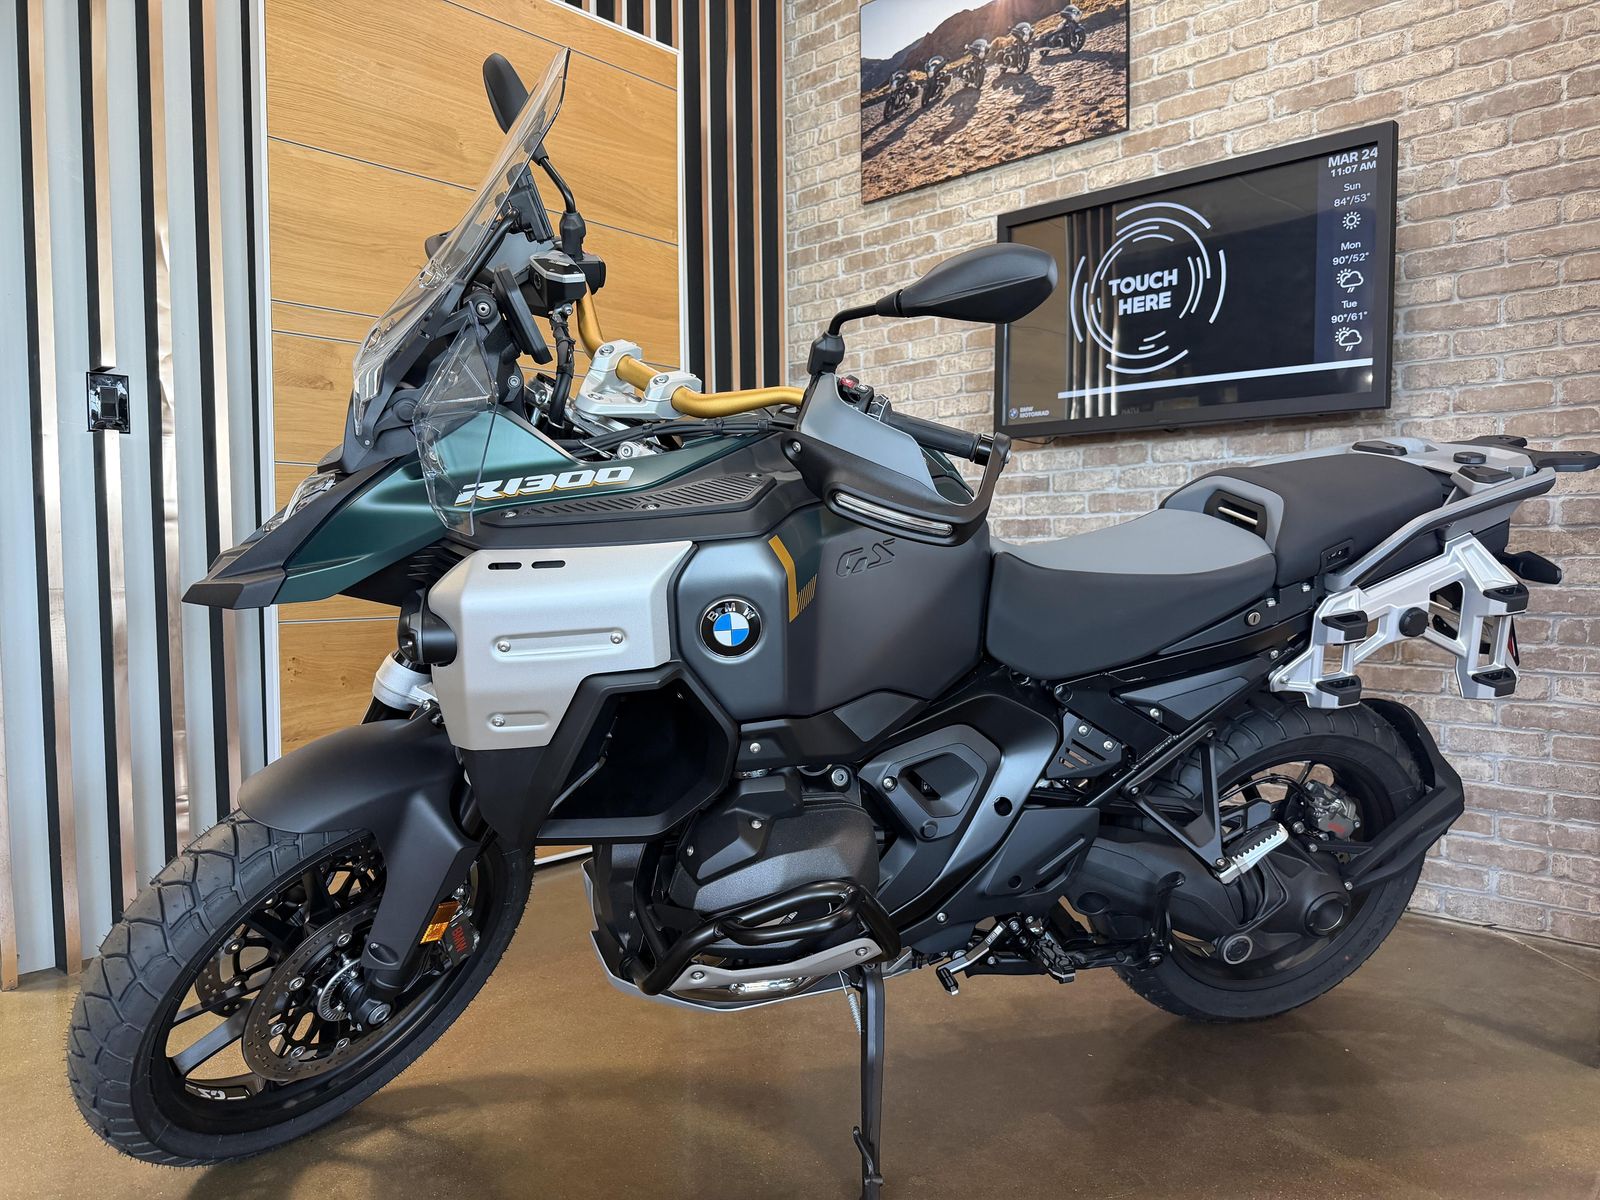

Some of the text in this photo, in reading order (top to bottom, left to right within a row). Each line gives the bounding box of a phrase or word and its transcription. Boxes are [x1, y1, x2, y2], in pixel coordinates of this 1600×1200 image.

[1328, 146, 1378, 168] MAR 24
[1330, 160, 1377, 177] 11:07 AM
[1343, 182, 1361, 192] Sun
[1340, 241, 1362, 252] Mon
[1108, 268, 1178, 297] TOUCH
[1118, 290, 1172, 316] HERE
[1341, 300, 1358, 309] Tue
[836, 537, 896, 577] GS
[706, 602, 756, 622] BMW
